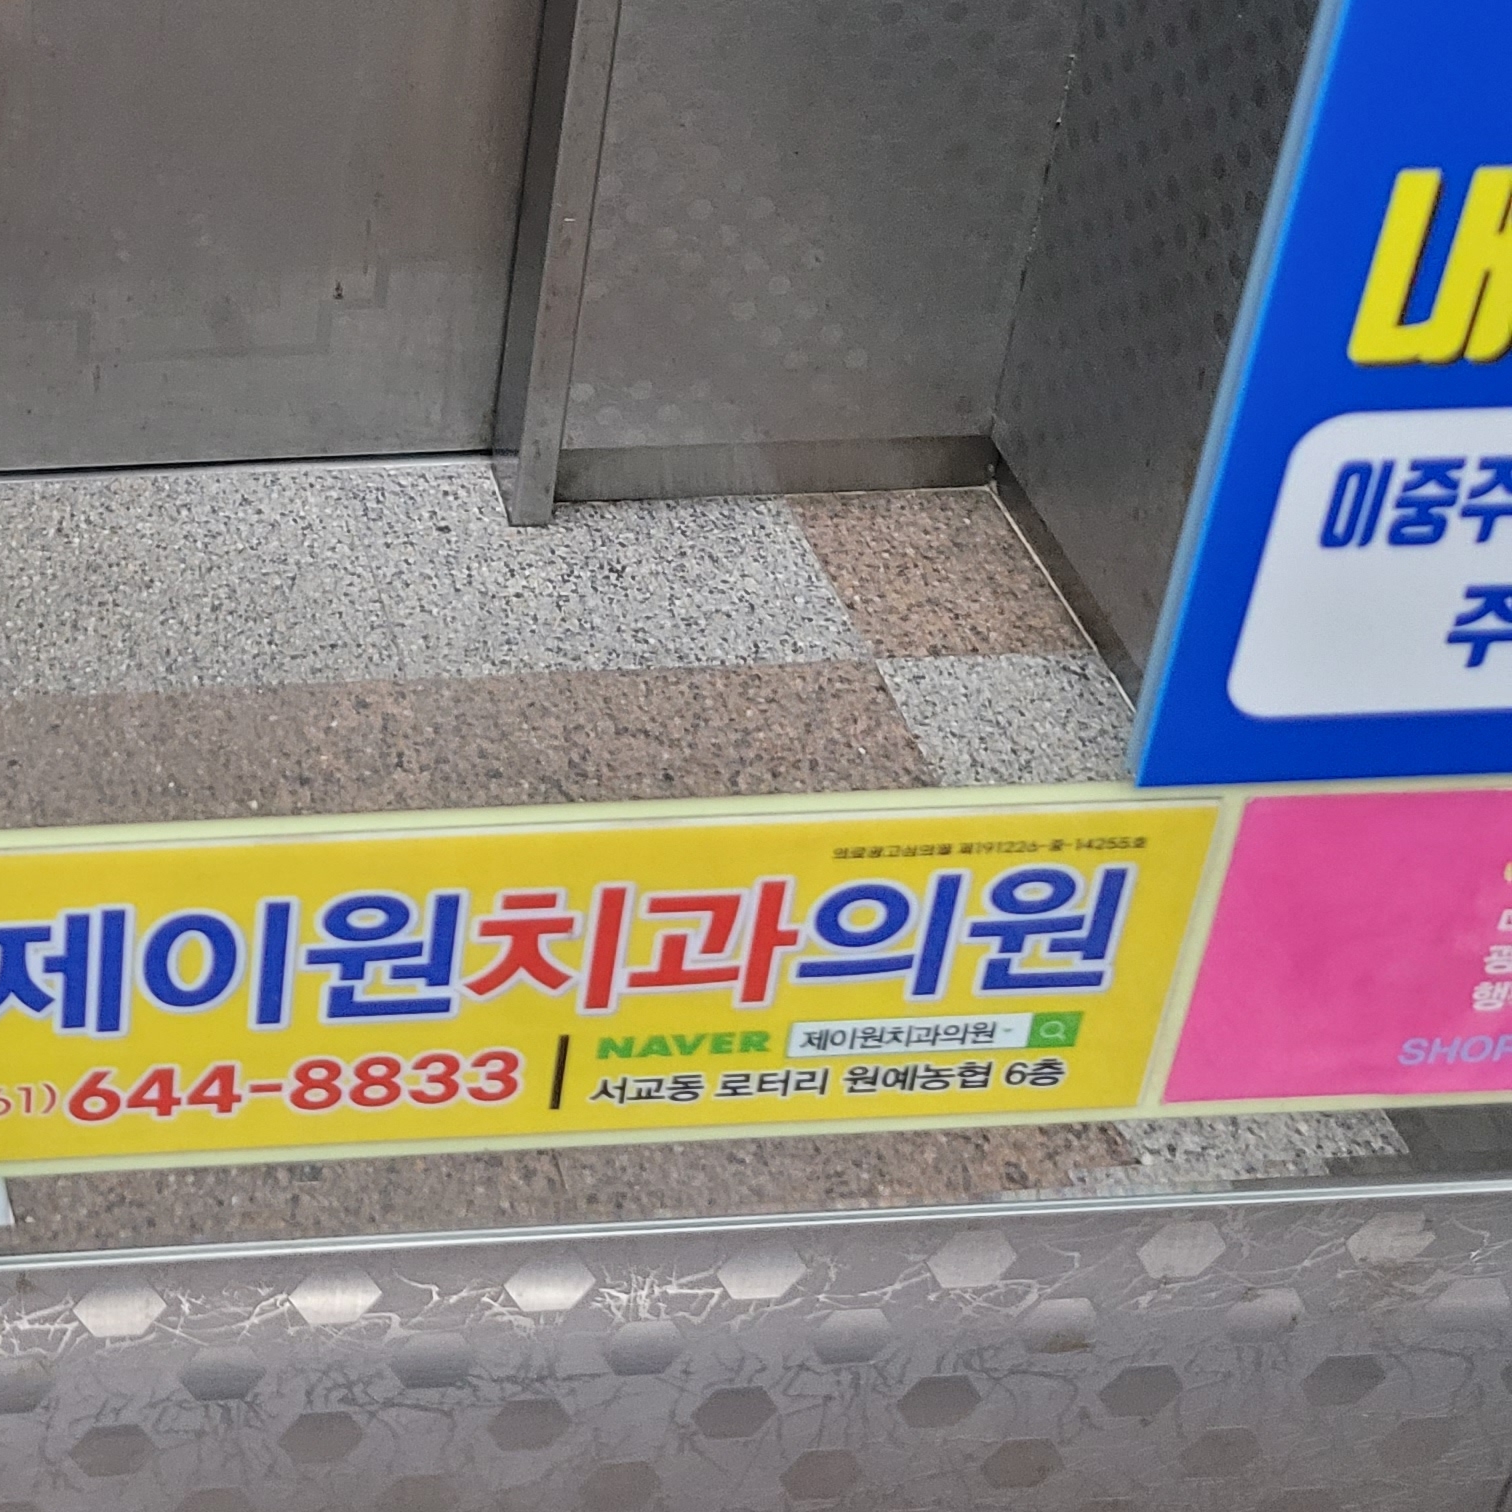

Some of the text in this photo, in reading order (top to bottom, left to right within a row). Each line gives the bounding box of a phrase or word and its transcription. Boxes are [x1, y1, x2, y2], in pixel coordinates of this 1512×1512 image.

[595, 1031, 771, 1061] NAVER
[798, 1020, 998, 1053] 제이원치과의원
[589, 1056, 1066, 1106] 서교동 로터리 원예농협 6층
